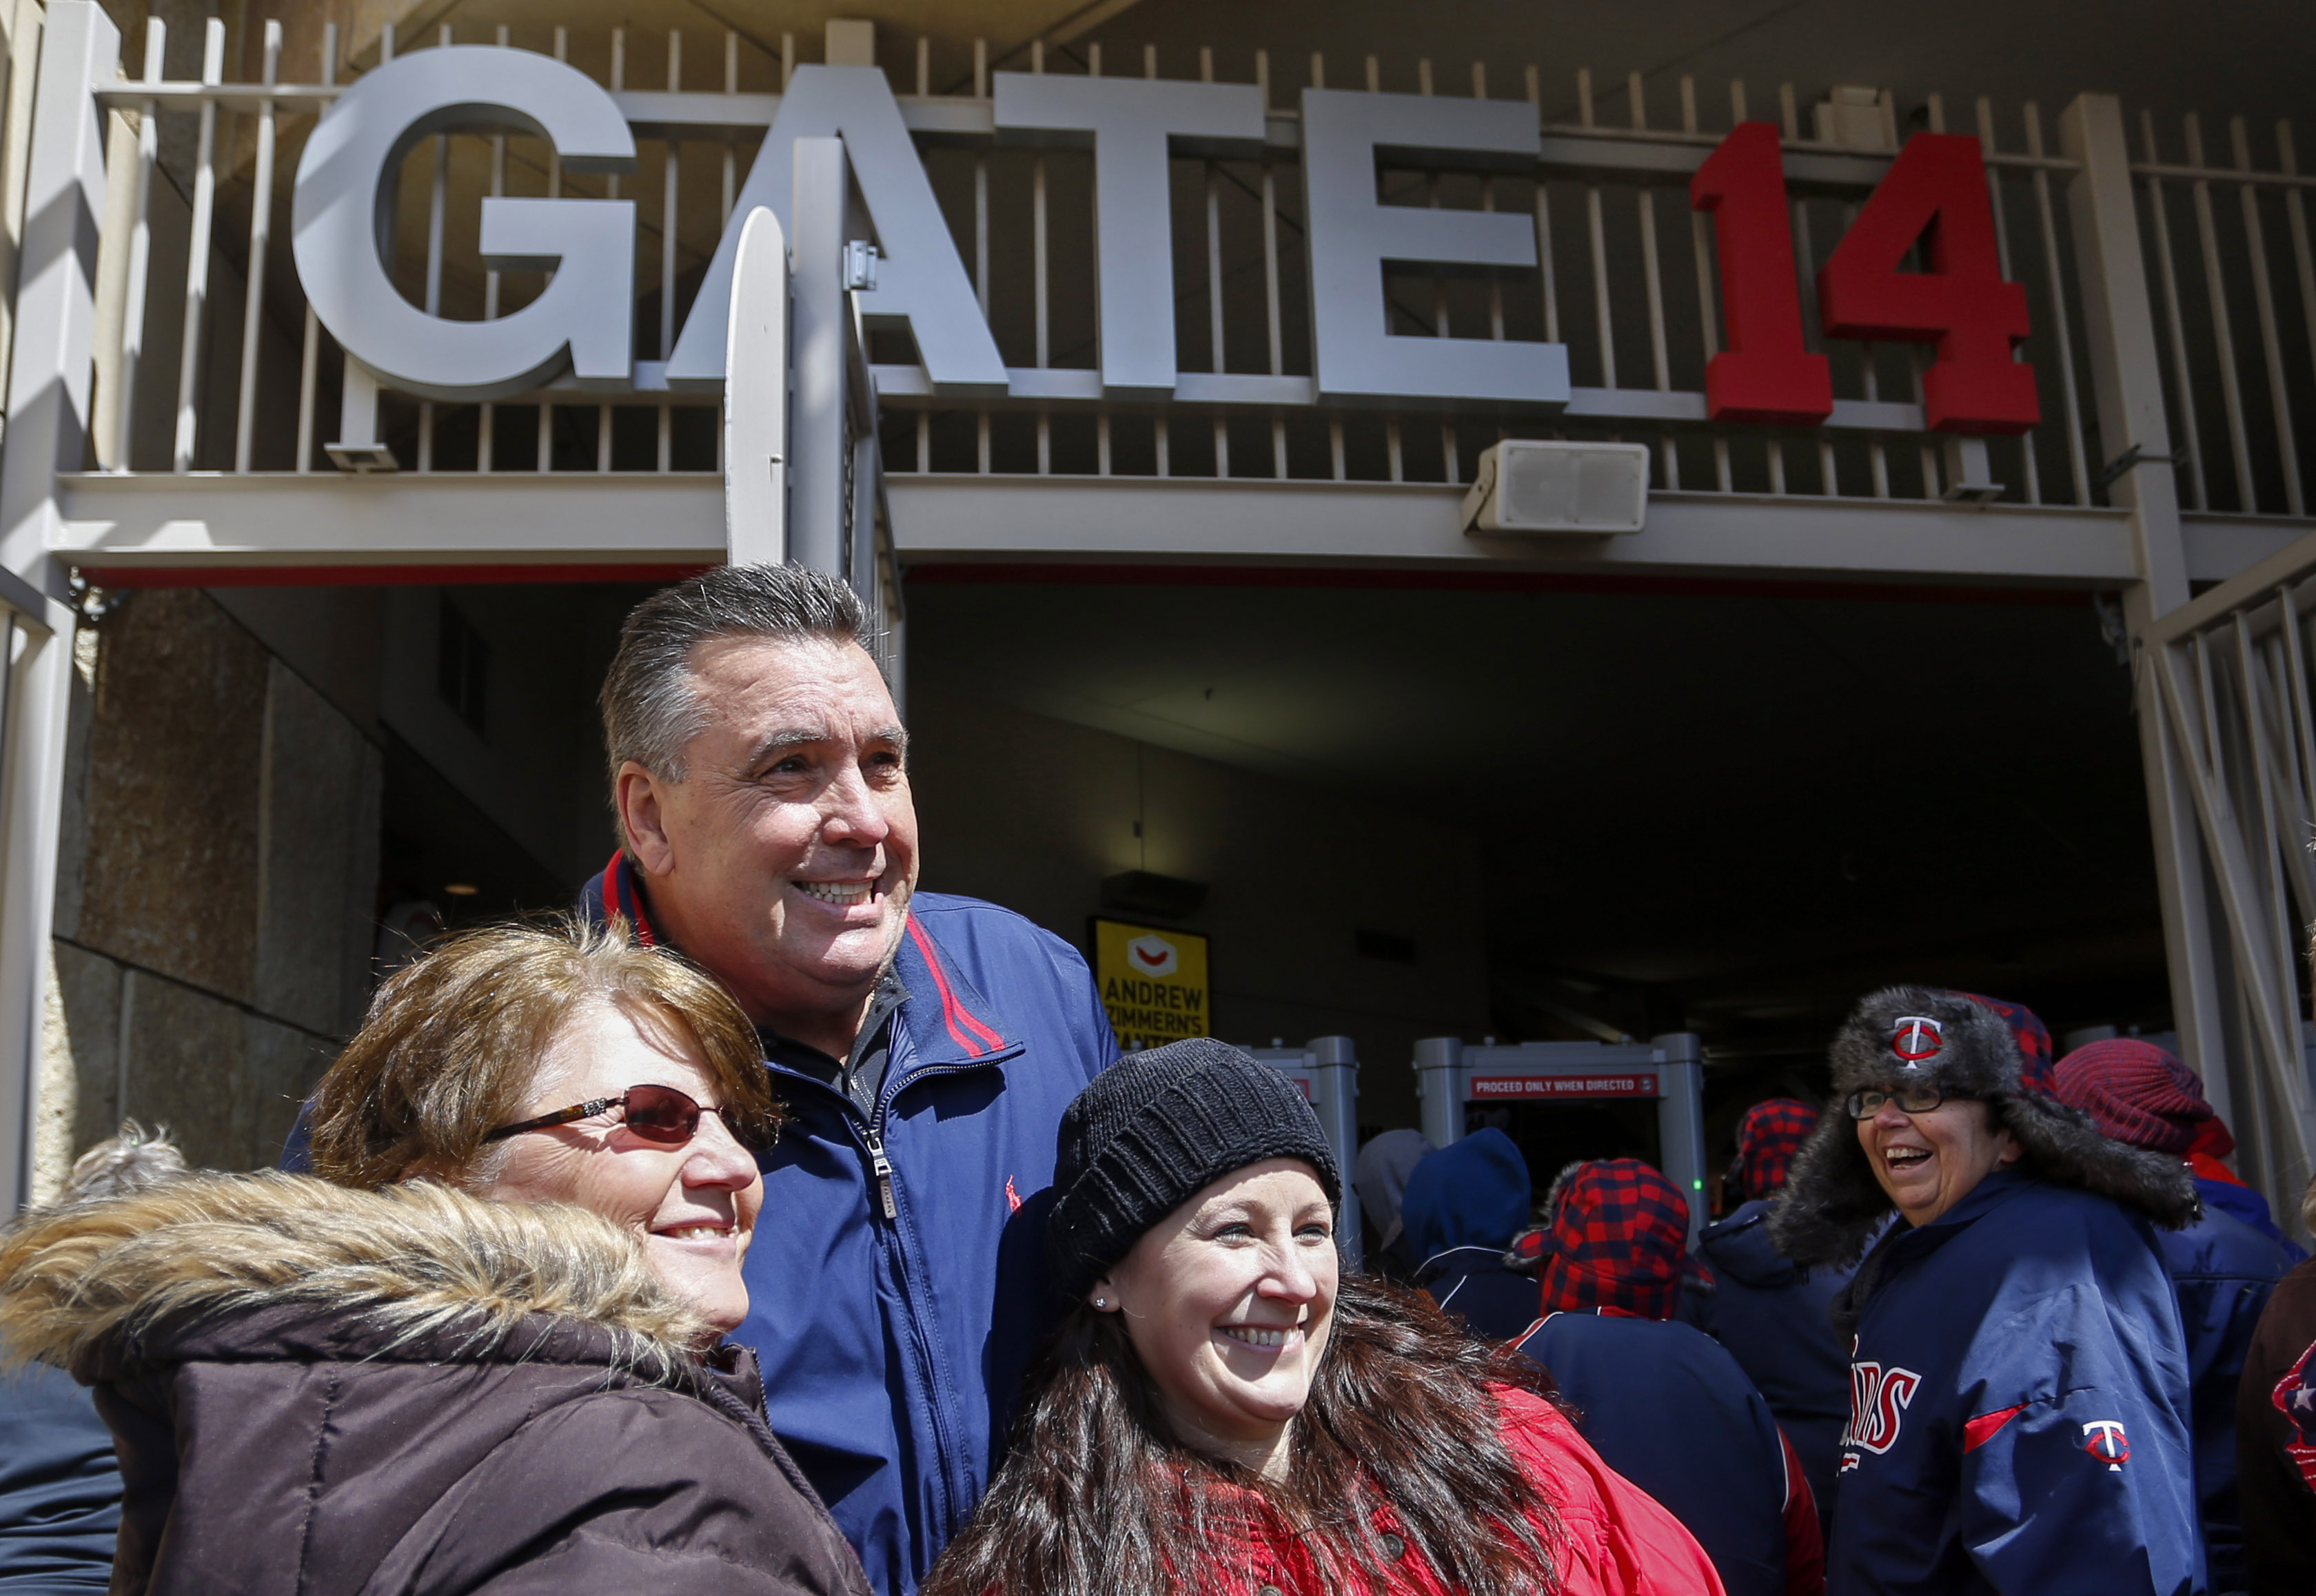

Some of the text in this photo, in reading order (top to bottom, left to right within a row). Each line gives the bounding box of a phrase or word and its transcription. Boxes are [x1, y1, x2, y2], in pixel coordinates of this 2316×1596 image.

[292, 44, 2039, 434] GATE 14
[1105, 976, 1201, 1012] ANDREW
[1106, 1004, 1201, 1035] ZIMMERN'S
[1476, 1078, 1634, 1092] PROCEED ONLY WHEN DIRECTED
